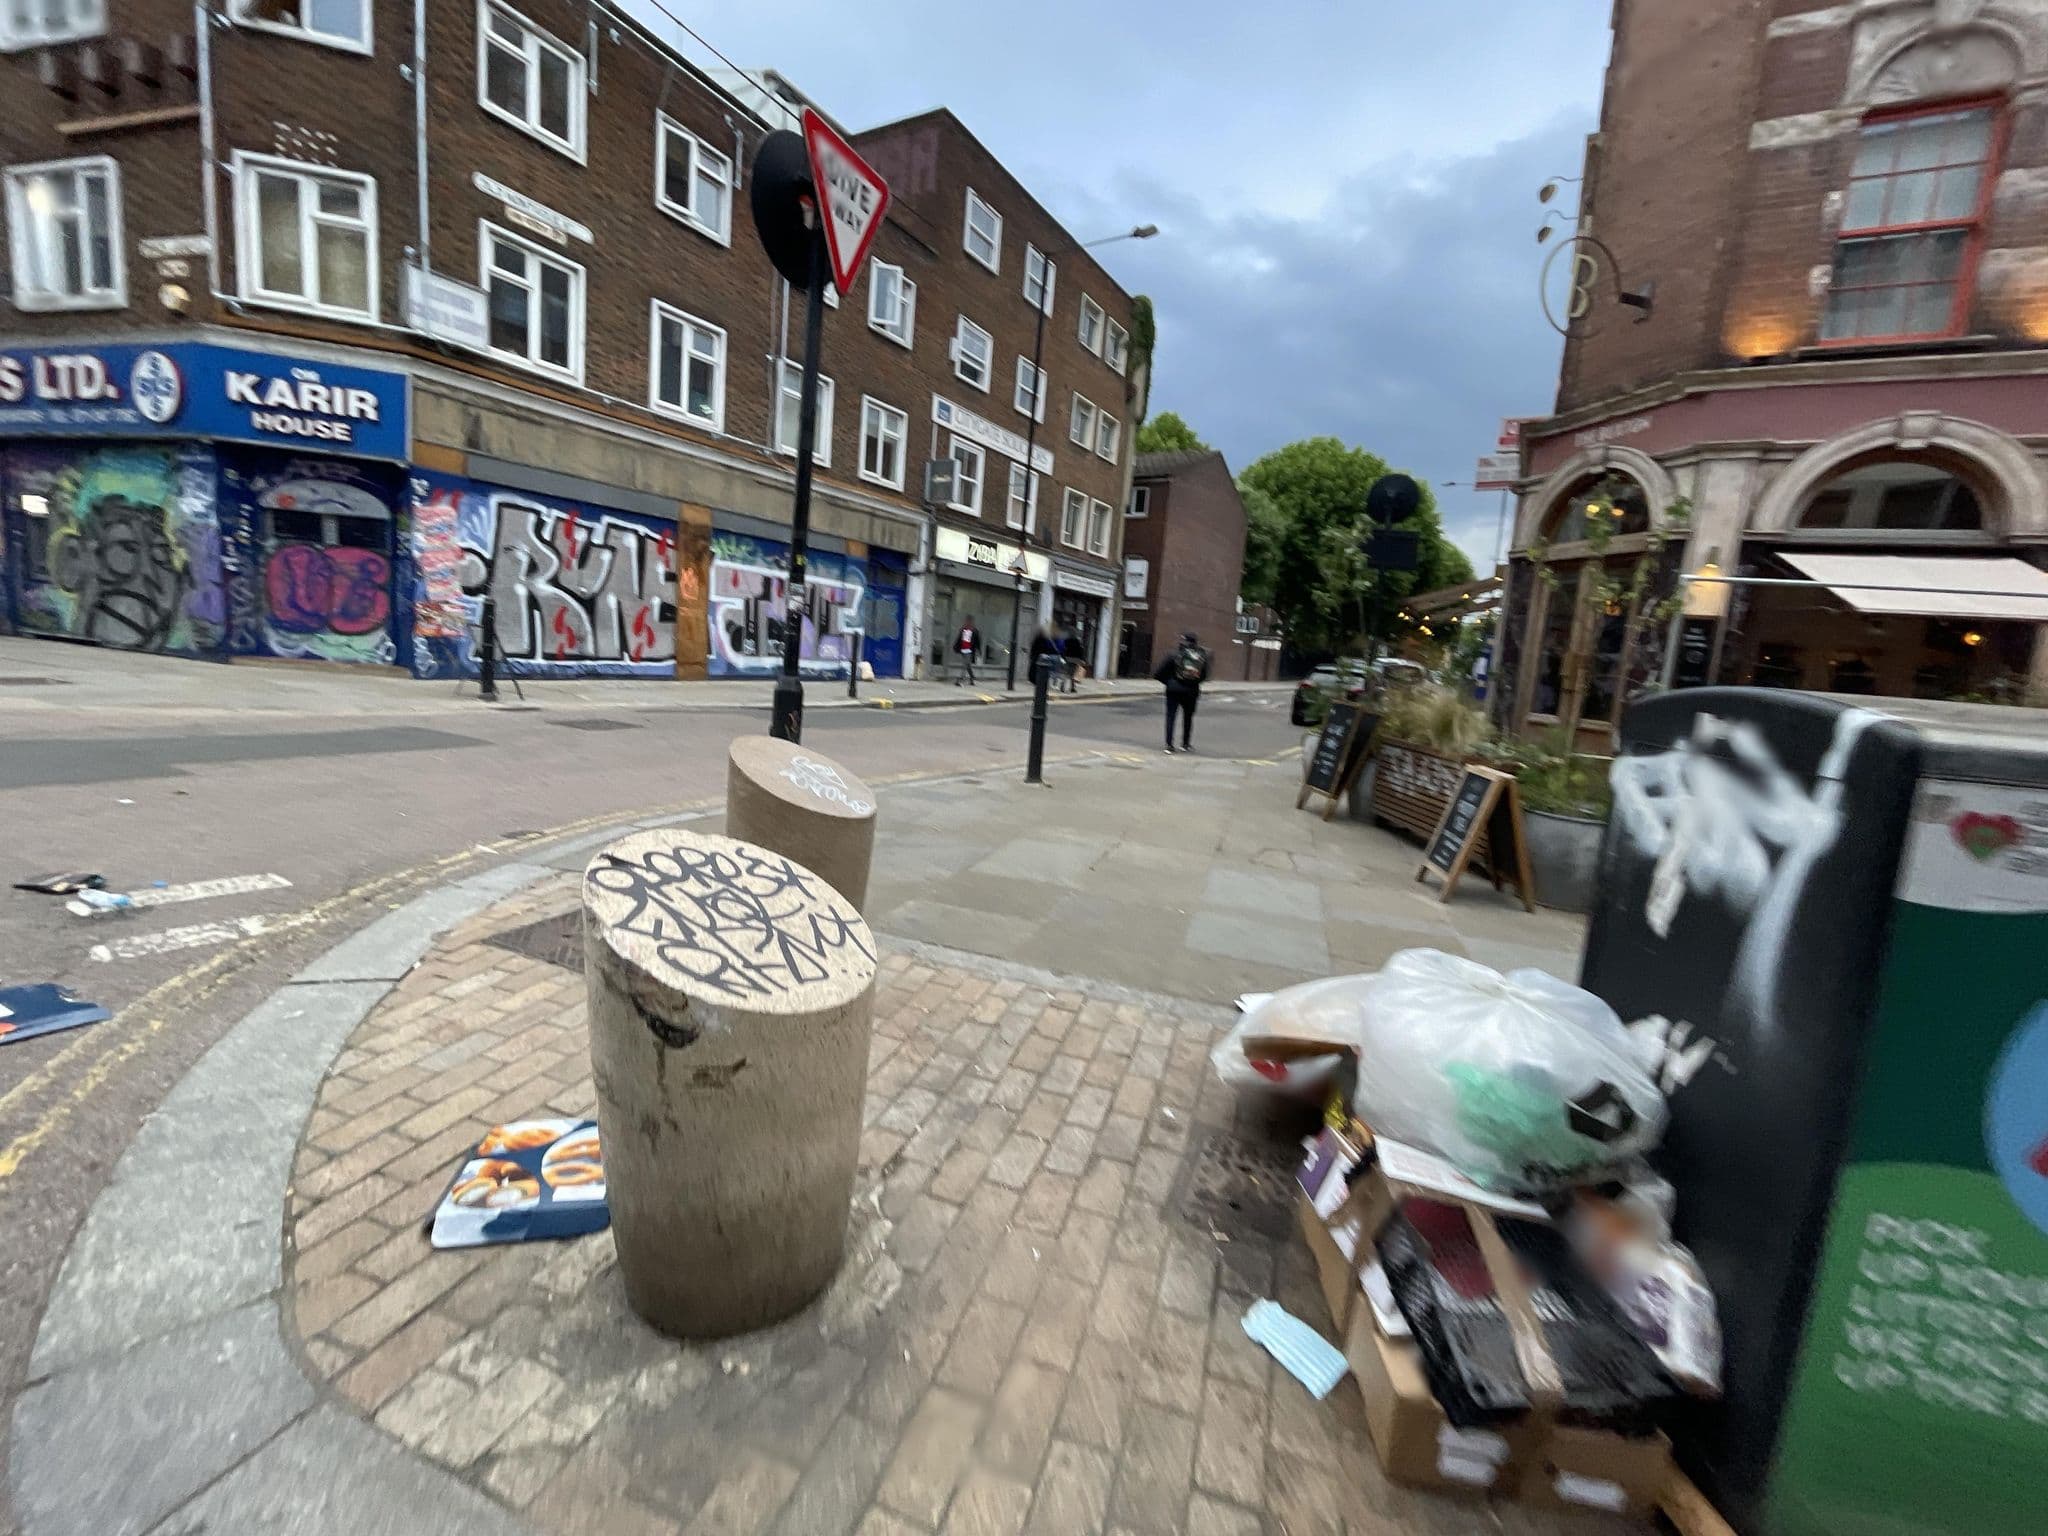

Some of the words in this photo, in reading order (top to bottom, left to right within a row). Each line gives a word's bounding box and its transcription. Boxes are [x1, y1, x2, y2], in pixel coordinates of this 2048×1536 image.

[33, 354, 120, 400] LTD.
[225, 370, 380, 422] KARIR
[252, 411, 353, 443] HOUSE
[997, 427, 1049, 464] SOLICIORS
